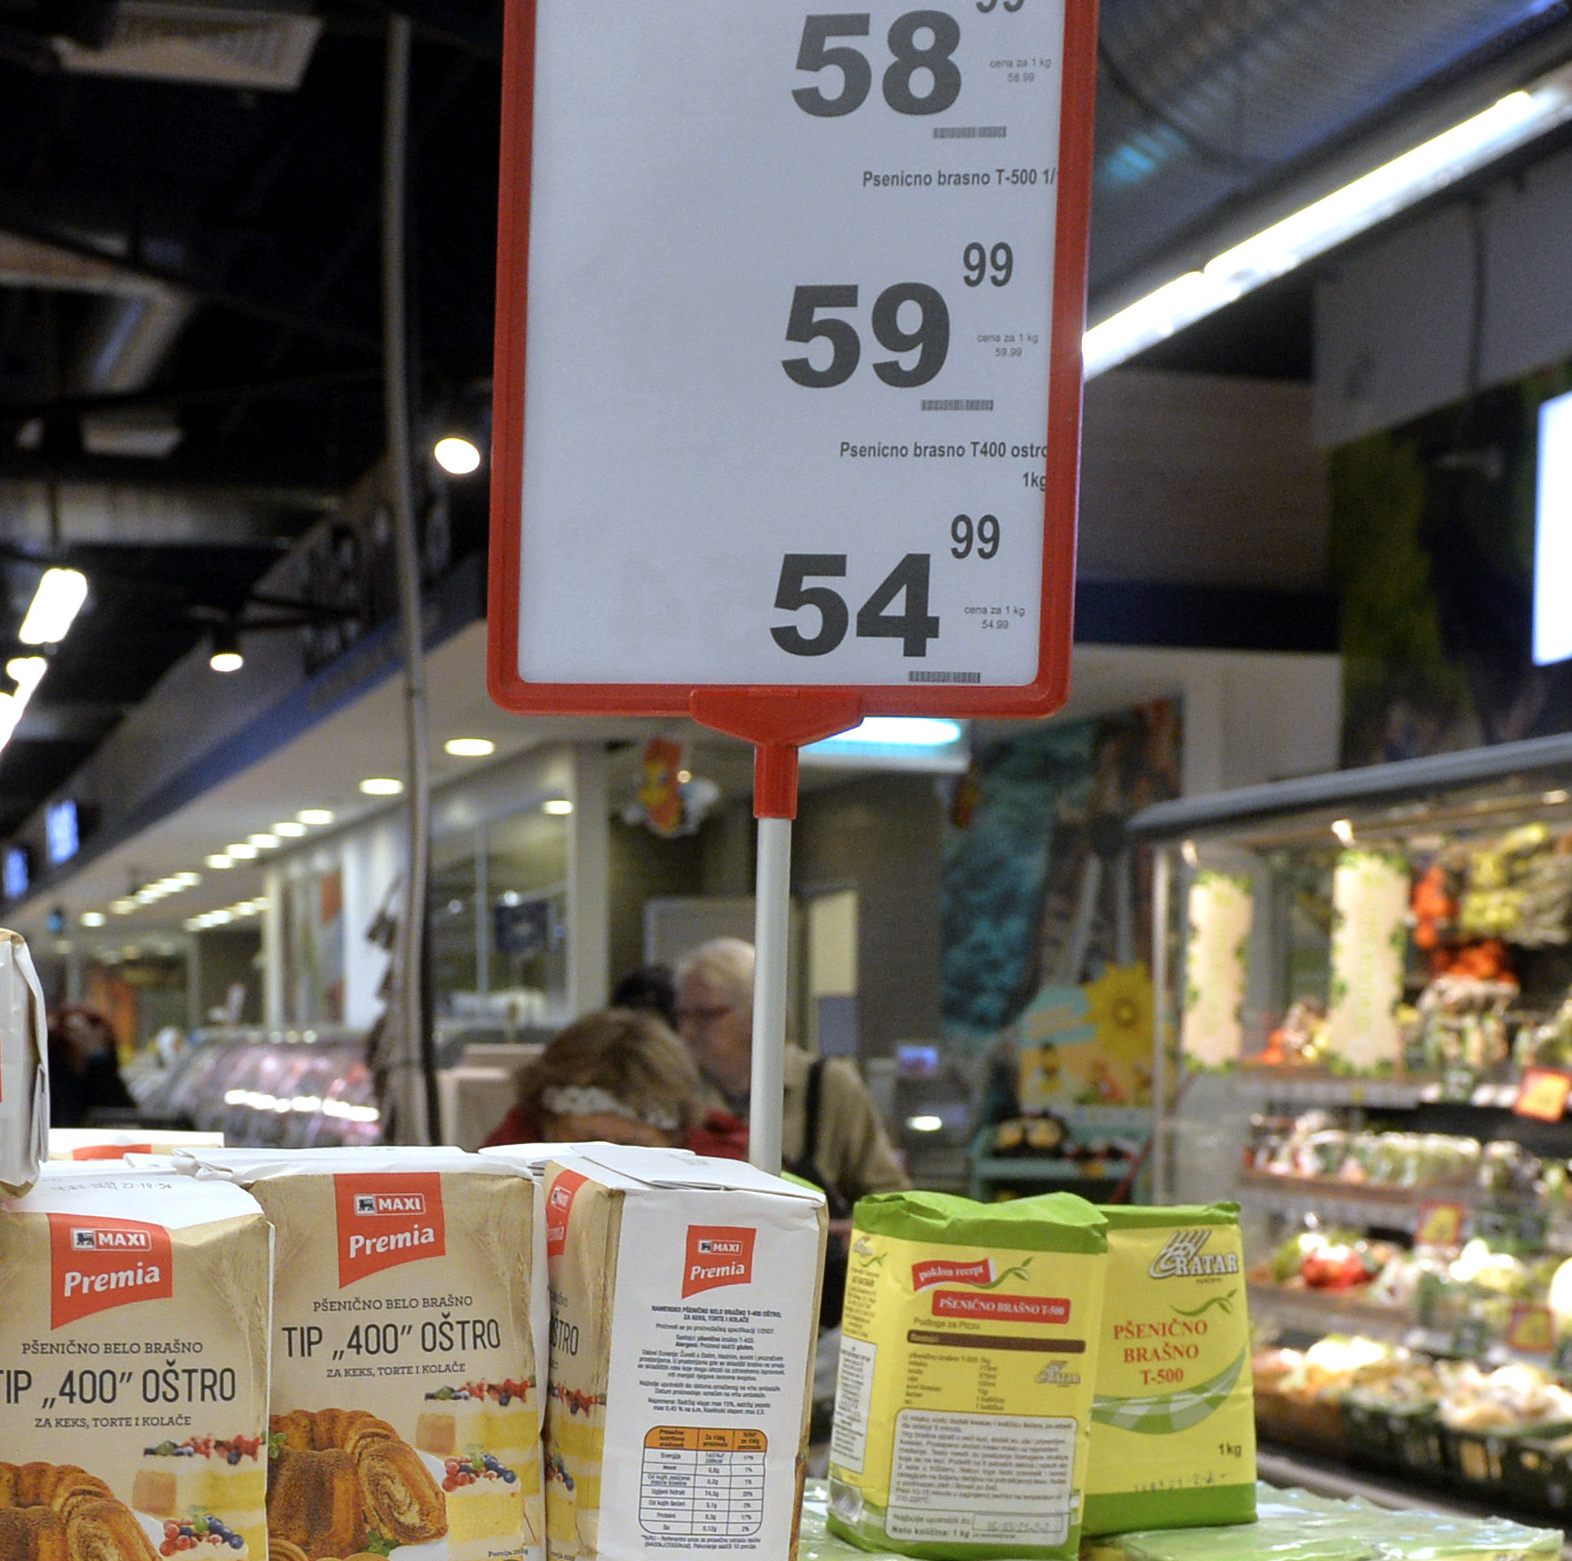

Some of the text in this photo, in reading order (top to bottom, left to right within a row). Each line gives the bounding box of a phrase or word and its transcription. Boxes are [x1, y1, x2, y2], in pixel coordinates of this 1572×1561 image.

[791, 10, 962, 117] 58
[990, 59, 1013, 68] cena
[1032, 58, 1036, 66] 1
[1040, 58, 1051, 68] kg
[863, 171, 932, 187] Psenicno
[938, 170, 990, 186] brasno
[996, 169, 1037, 185] T-500
[781, 242, 1013, 388] 59 99
[978, 334, 1038, 343] cena za 1 kg
[995, 347, 1022, 357] 59.99
[840, 441, 910, 458] Psenicno
[914, 441, 965, 458] brasno
[971, 441, 1006, 458] T400
[1023, 472, 1046, 491] 1kg
[769, 514, 1000, 658] 54 99
[964, 605, 1025, 617] cena za 1 kg
[982, 620, 1009, 629] 54.99
[98, 1232, 146, 1247] MAXI
[713, 1240, 740, 1254] MAXI
[64, 1262, 161, 1297] Premia
[691, 1260, 745, 1281] Premia
[939, 1296, 1065, 1316] PŠENIČNO BRAŠNO T-500
[1113, 1319, 1208, 1341] PŠENIČNO
[22, 1338, 203, 1355] PŠENIČNO BELO BRAŠNO
[1123, 1343, 1200, 1364] BRAŠNO
[142, 1359, 236, 1403] OŠTRO
[1140, 1367, 1183, 1385] T-500
[34, 1417, 52, 1428] ZA
[92, 1416, 133, 1428] TORTE
[142, 1413, 192, 1427] KOLAČE
[1219, 1443, 1242, 1457] 1kg
